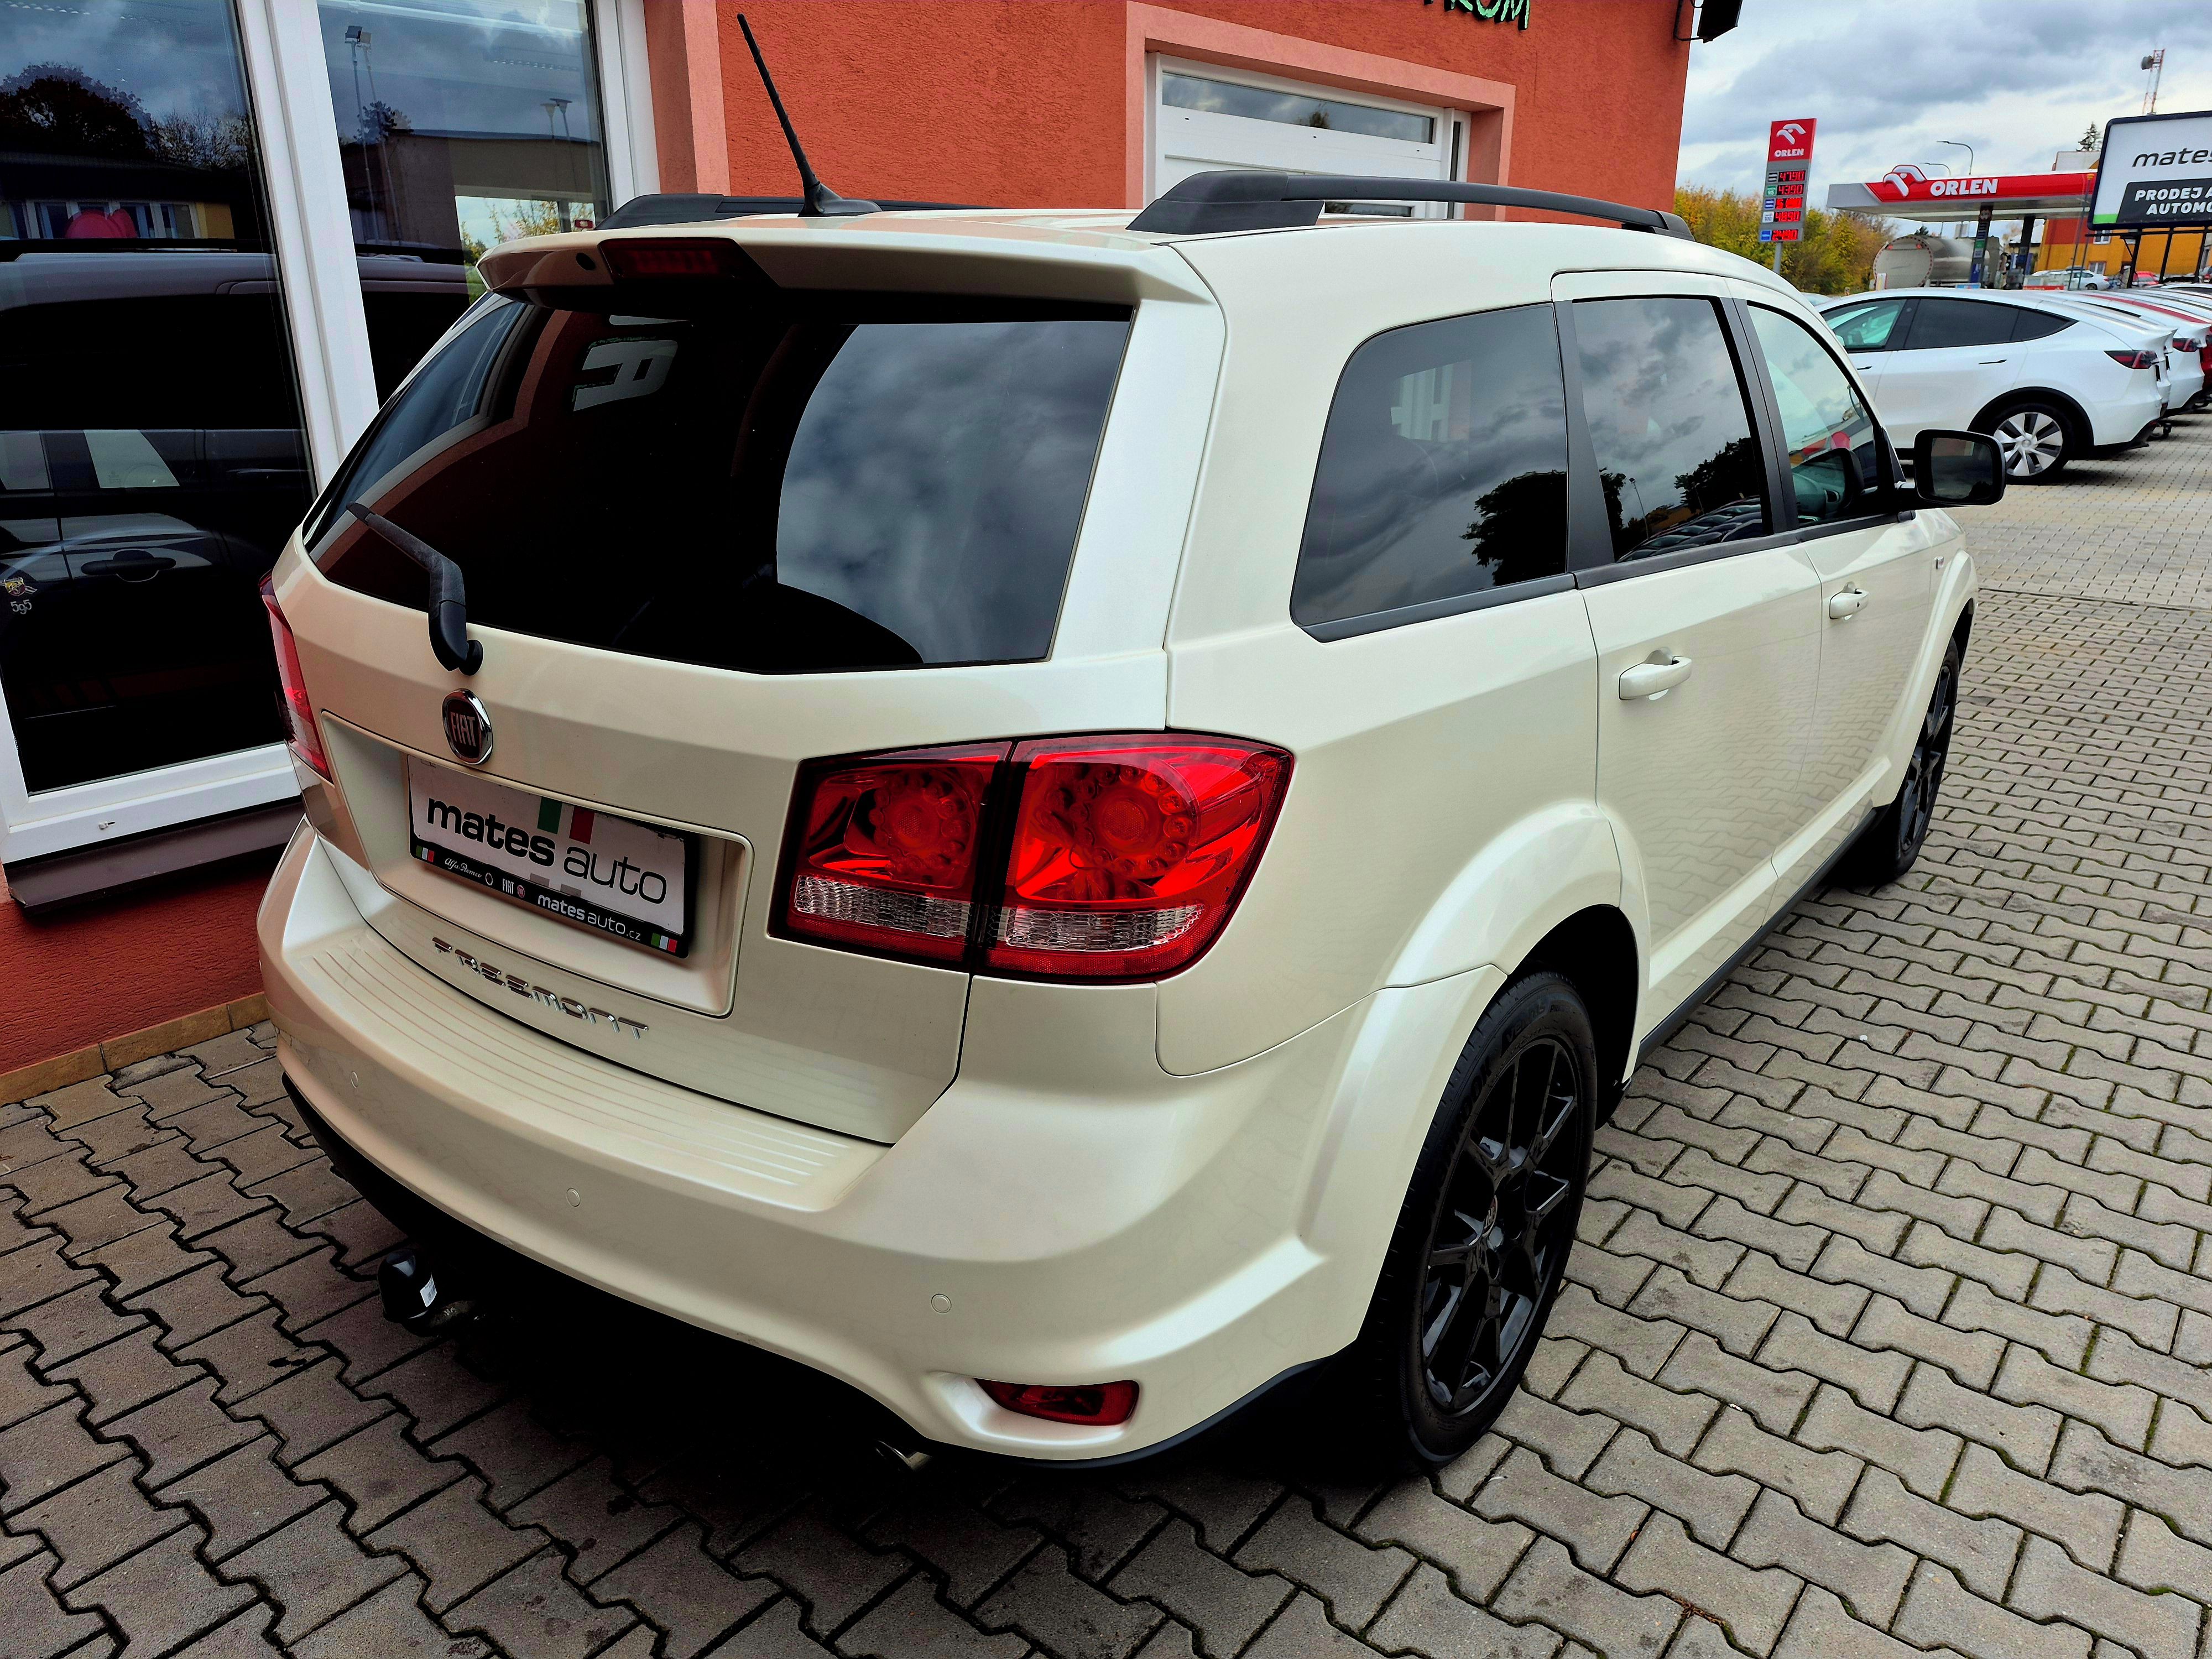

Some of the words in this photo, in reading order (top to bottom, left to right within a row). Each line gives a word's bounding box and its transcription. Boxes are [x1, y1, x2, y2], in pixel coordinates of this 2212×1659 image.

[1775, 148, 1804, 157] ORLEN
[2132, 148, 2212, 167] mate
[1930, 179, 1998, 196] ORLEN
[2135, 187, 2203, 201] PRODEJ
[11, 599, 32, 614] 595
[450, 712, 476, 747] FIAT
[427, 797, 555, 867] mates
[563, 846, 667, 904] auto
[445, 858, 460, 870] Alfa
[502, 878, 514, 895] FIAT
[432, 937, 649, 1040] FREEMONT
